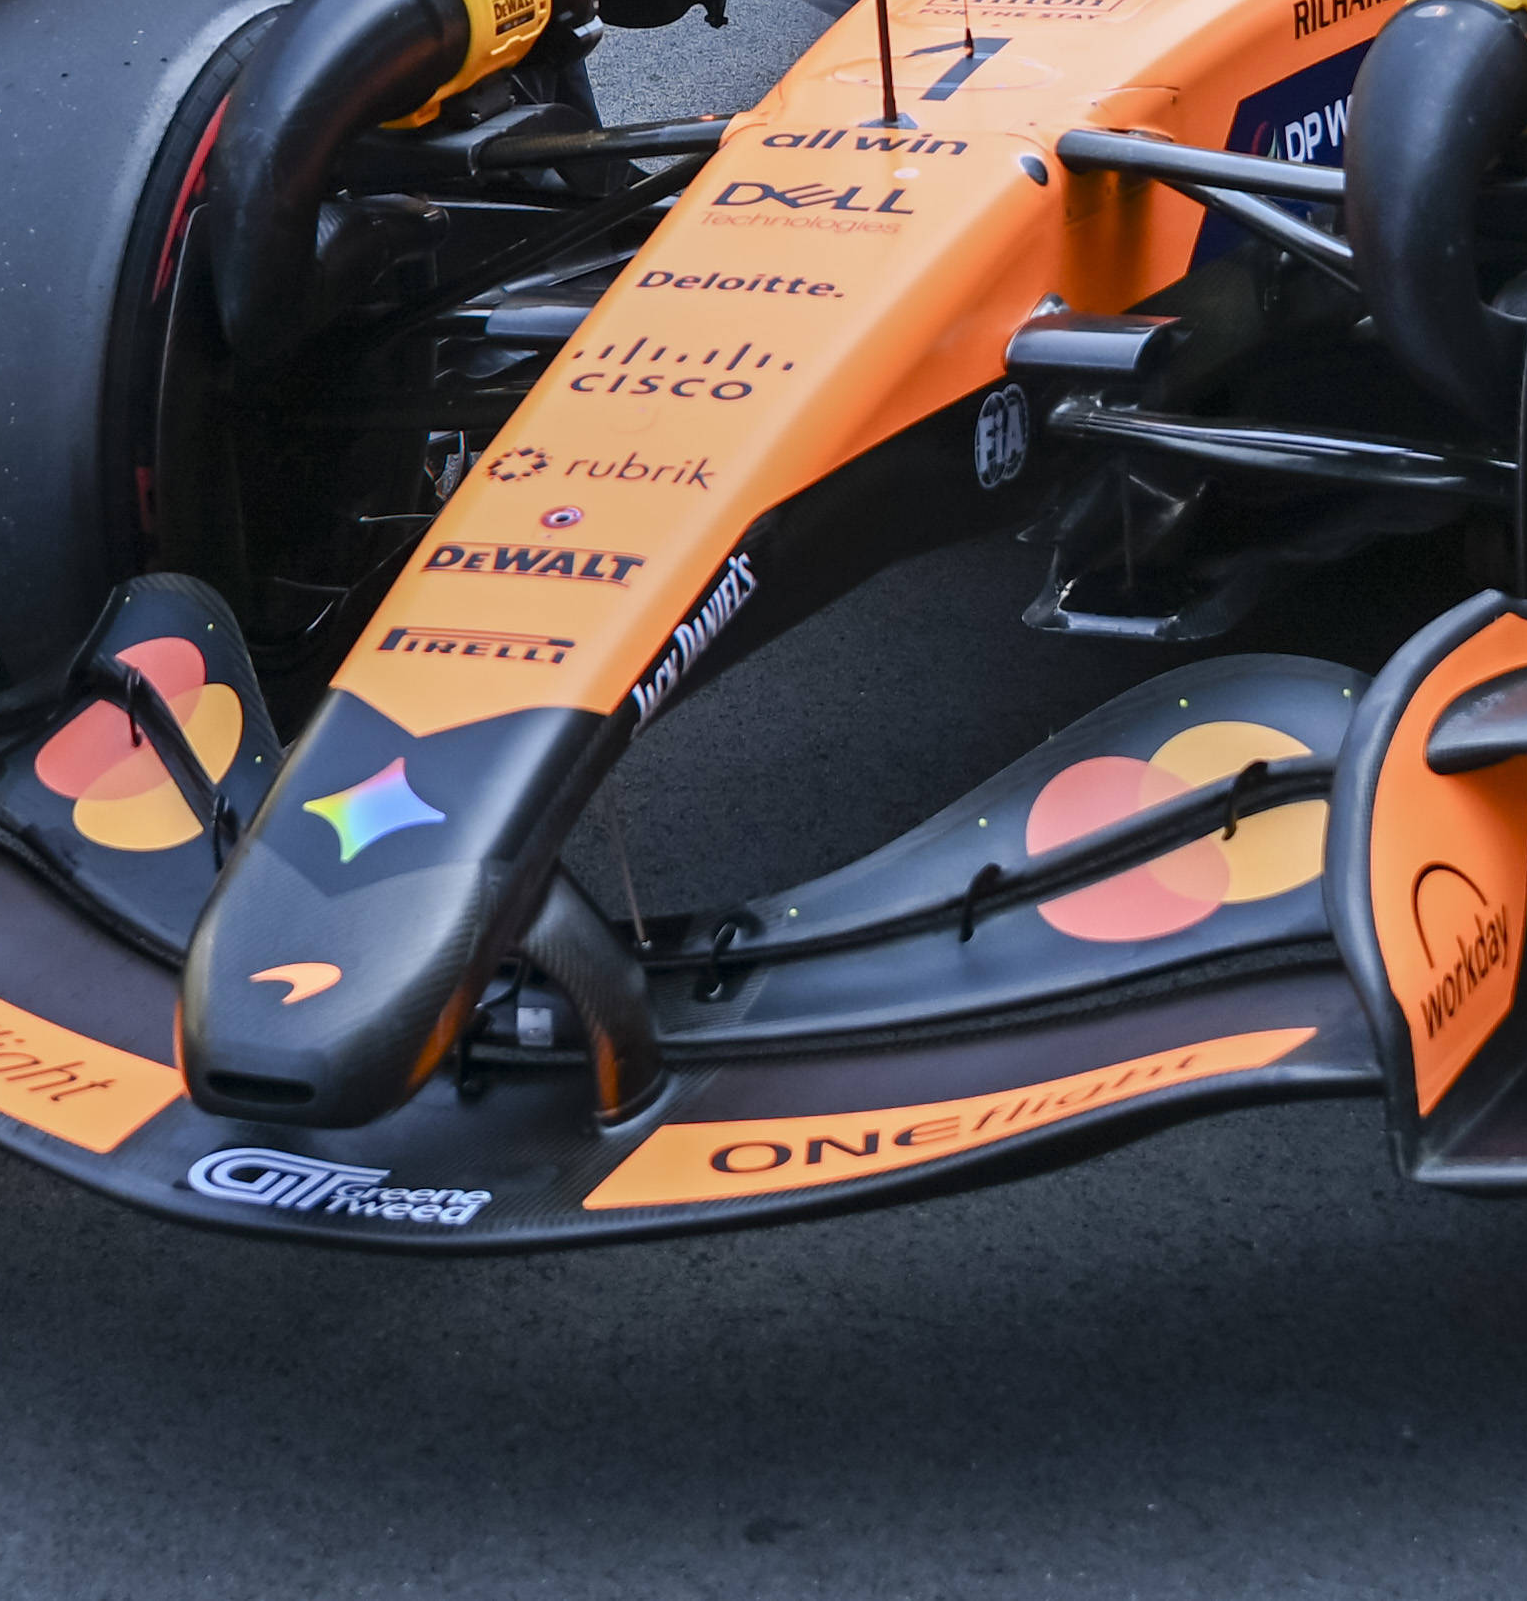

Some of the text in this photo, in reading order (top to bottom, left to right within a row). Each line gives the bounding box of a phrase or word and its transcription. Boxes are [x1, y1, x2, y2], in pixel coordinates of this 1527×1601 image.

[919, 8, 968, 16] FOR
[904, 37, 1012, 101] 1
[762, 128, 968, 157] all win
[1283, 117, 1322, 165] DP
[711, 180, 916, 216] DELL
[700, 209, 901, 235] Technologies
[636, 269, 846, 299] Deloitte.
[569, 372, 754, 400] CISCO
[564, 452, 718, 491] rubrik
[376, 626, 577, 665] PIRELLI
[631, 552, 758, 727] JACK DANIEL'S
[1420, 899, 1515, 1040] workday
[710, 1050, 1206, 1175] ONEflight
[186, 1147, 390, 1211] GT
[331, 1178, 492, 1206] Greene
[324, 1197, 484, 1227] Tweed
